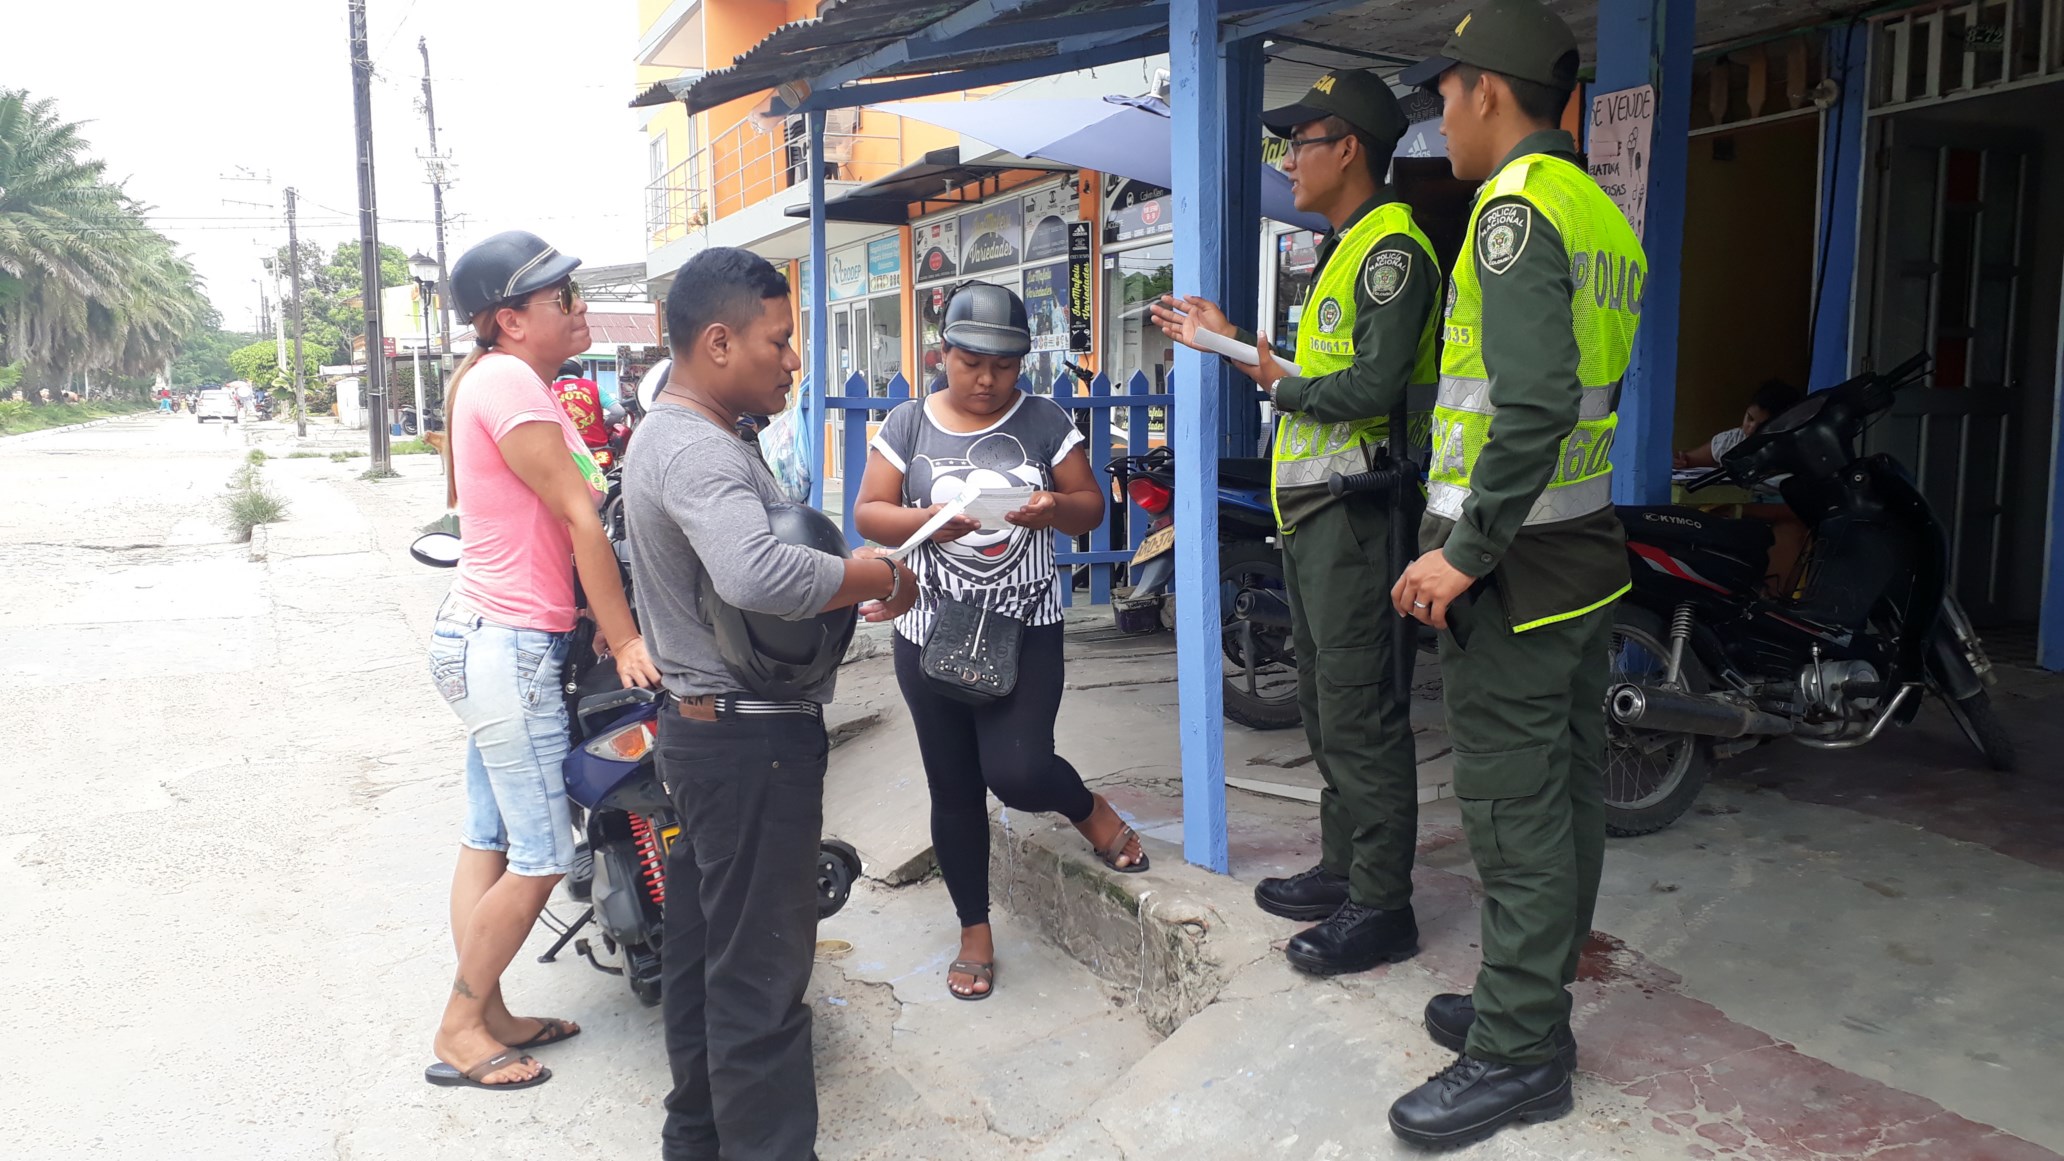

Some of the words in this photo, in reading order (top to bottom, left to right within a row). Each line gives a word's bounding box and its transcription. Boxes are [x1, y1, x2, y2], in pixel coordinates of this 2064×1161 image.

[1607, 90, 1651, 125] VENDE
[1589, 163, 1621, 177] ELATINA
[1481, 216, 1524, 237] NACIONAL
[969, 241, 1012, 264] Variedades
[1369, 259, 1407, 272] NACIONAL
[1081, 262, 1090, 320] Variedades
[1572, 250, 1648, 315] POLIC
[1660, 515, 1702, 529] KYMCO
[960, 577, 1052, 612] MICKEY
